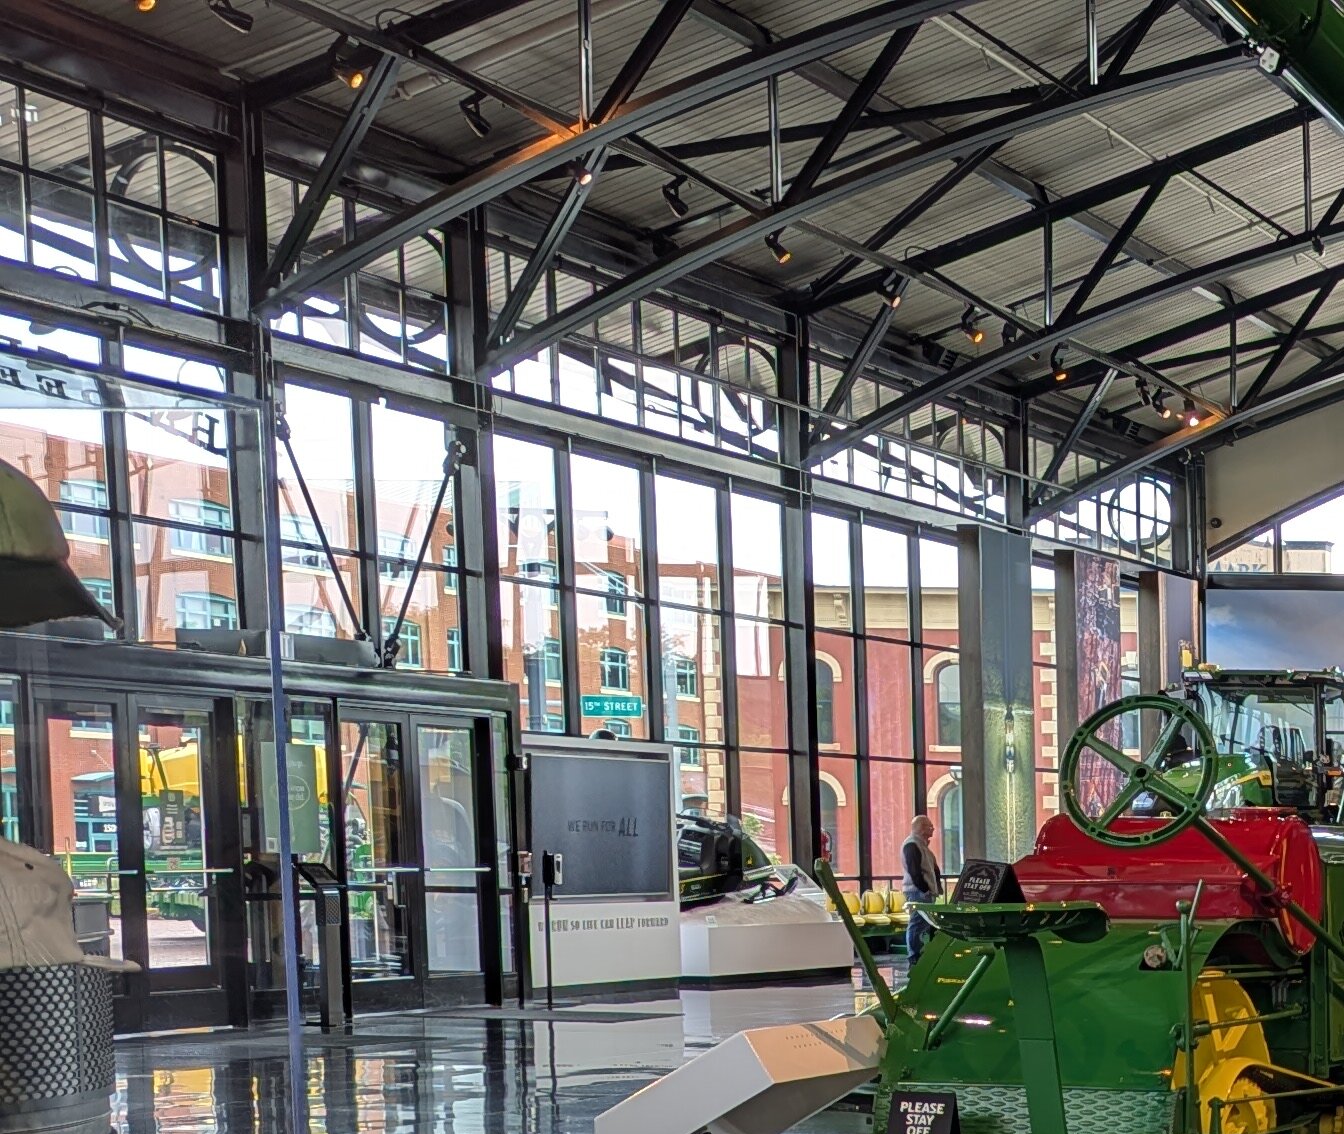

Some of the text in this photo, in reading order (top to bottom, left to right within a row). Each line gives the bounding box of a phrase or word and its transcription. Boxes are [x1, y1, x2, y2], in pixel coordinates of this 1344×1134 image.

[603, 701, 638, 711] STREET
[568, 817, 639, 837] WE RUN FOR ALL
[969, 876, 991, 885] PLEASE
[900, 1101, 945, 1115] PLEASE
[905, 1114, 935, 1126] STAY
